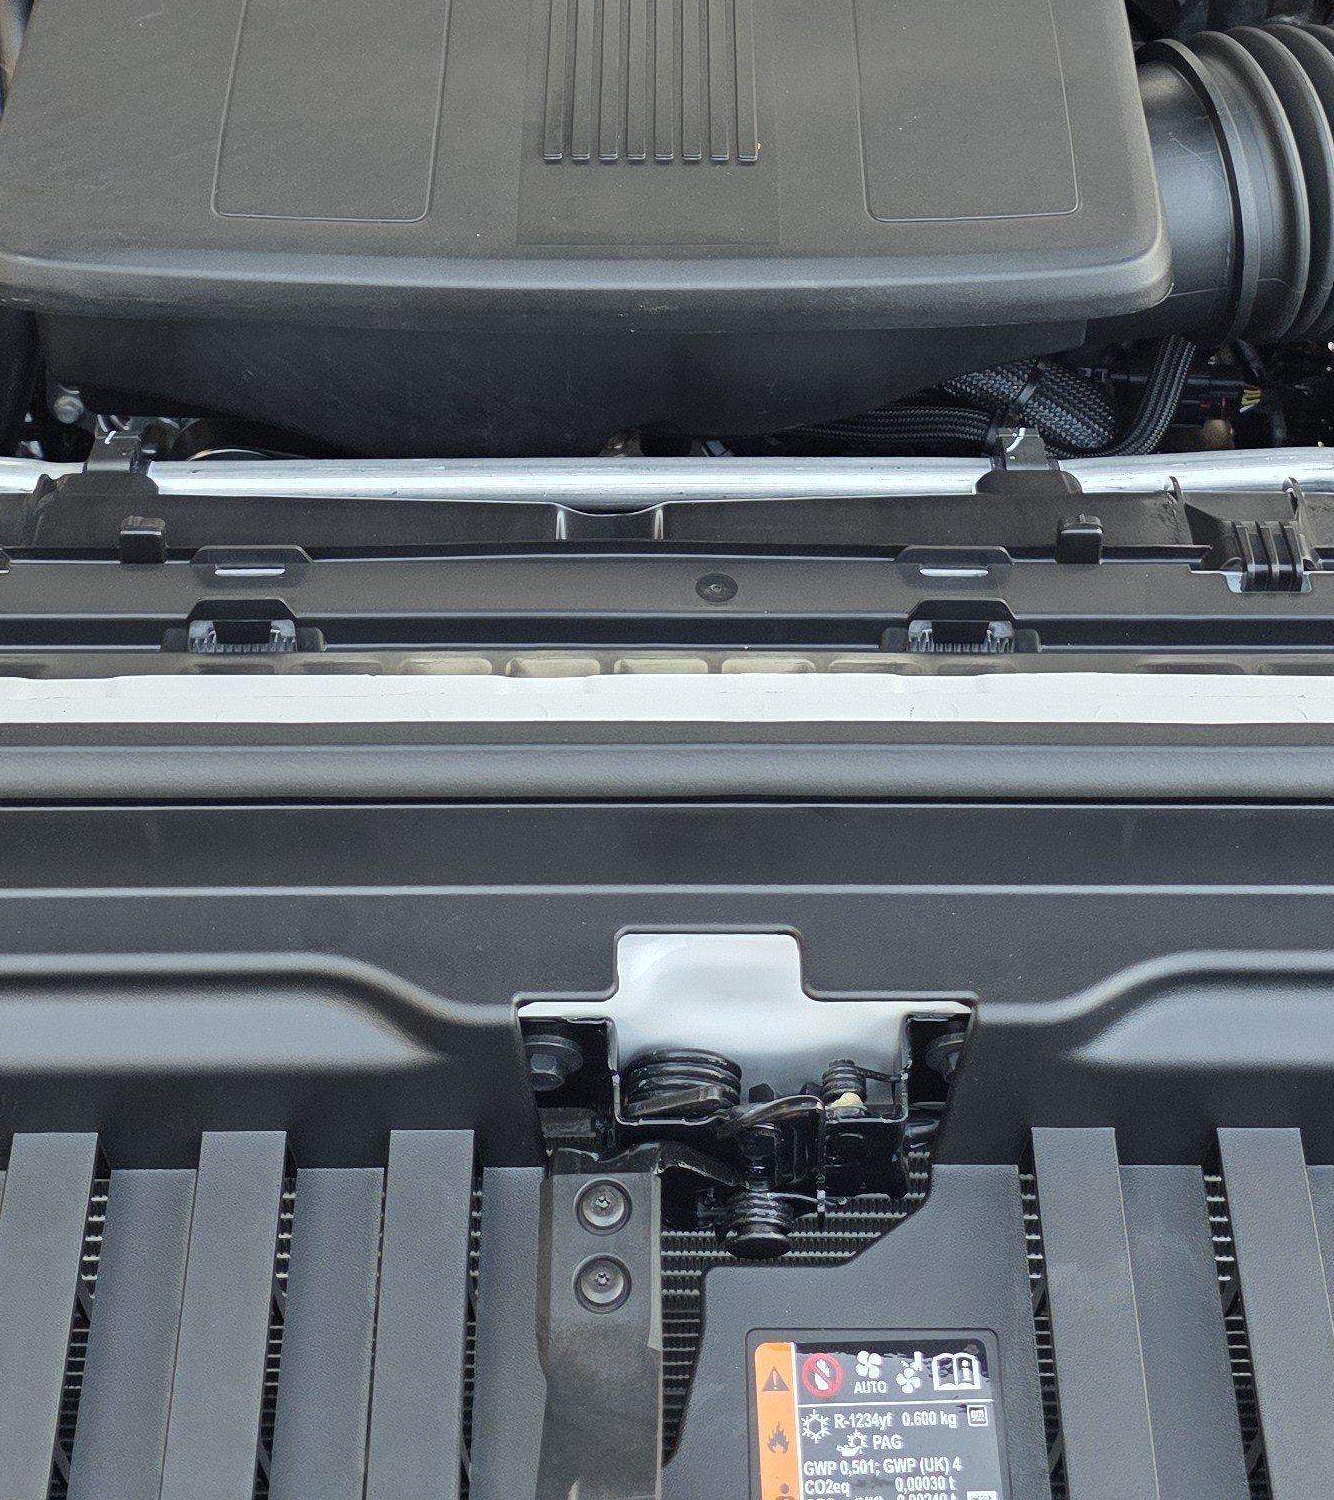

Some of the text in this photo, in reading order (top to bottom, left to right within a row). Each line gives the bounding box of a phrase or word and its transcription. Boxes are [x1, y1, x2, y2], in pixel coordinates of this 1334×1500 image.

[853, 1380, 888, 1394] AUTO
[833, 1410, 958, 1431] R-1234yf 0.600 kg
[872, 1434, 902, 1450] PAG
[803, 1455, 963, 1478] GWP 0,501; GWP (UK) 4
[804, 1475, 956, 1498] CO2eq 0,00030 t
